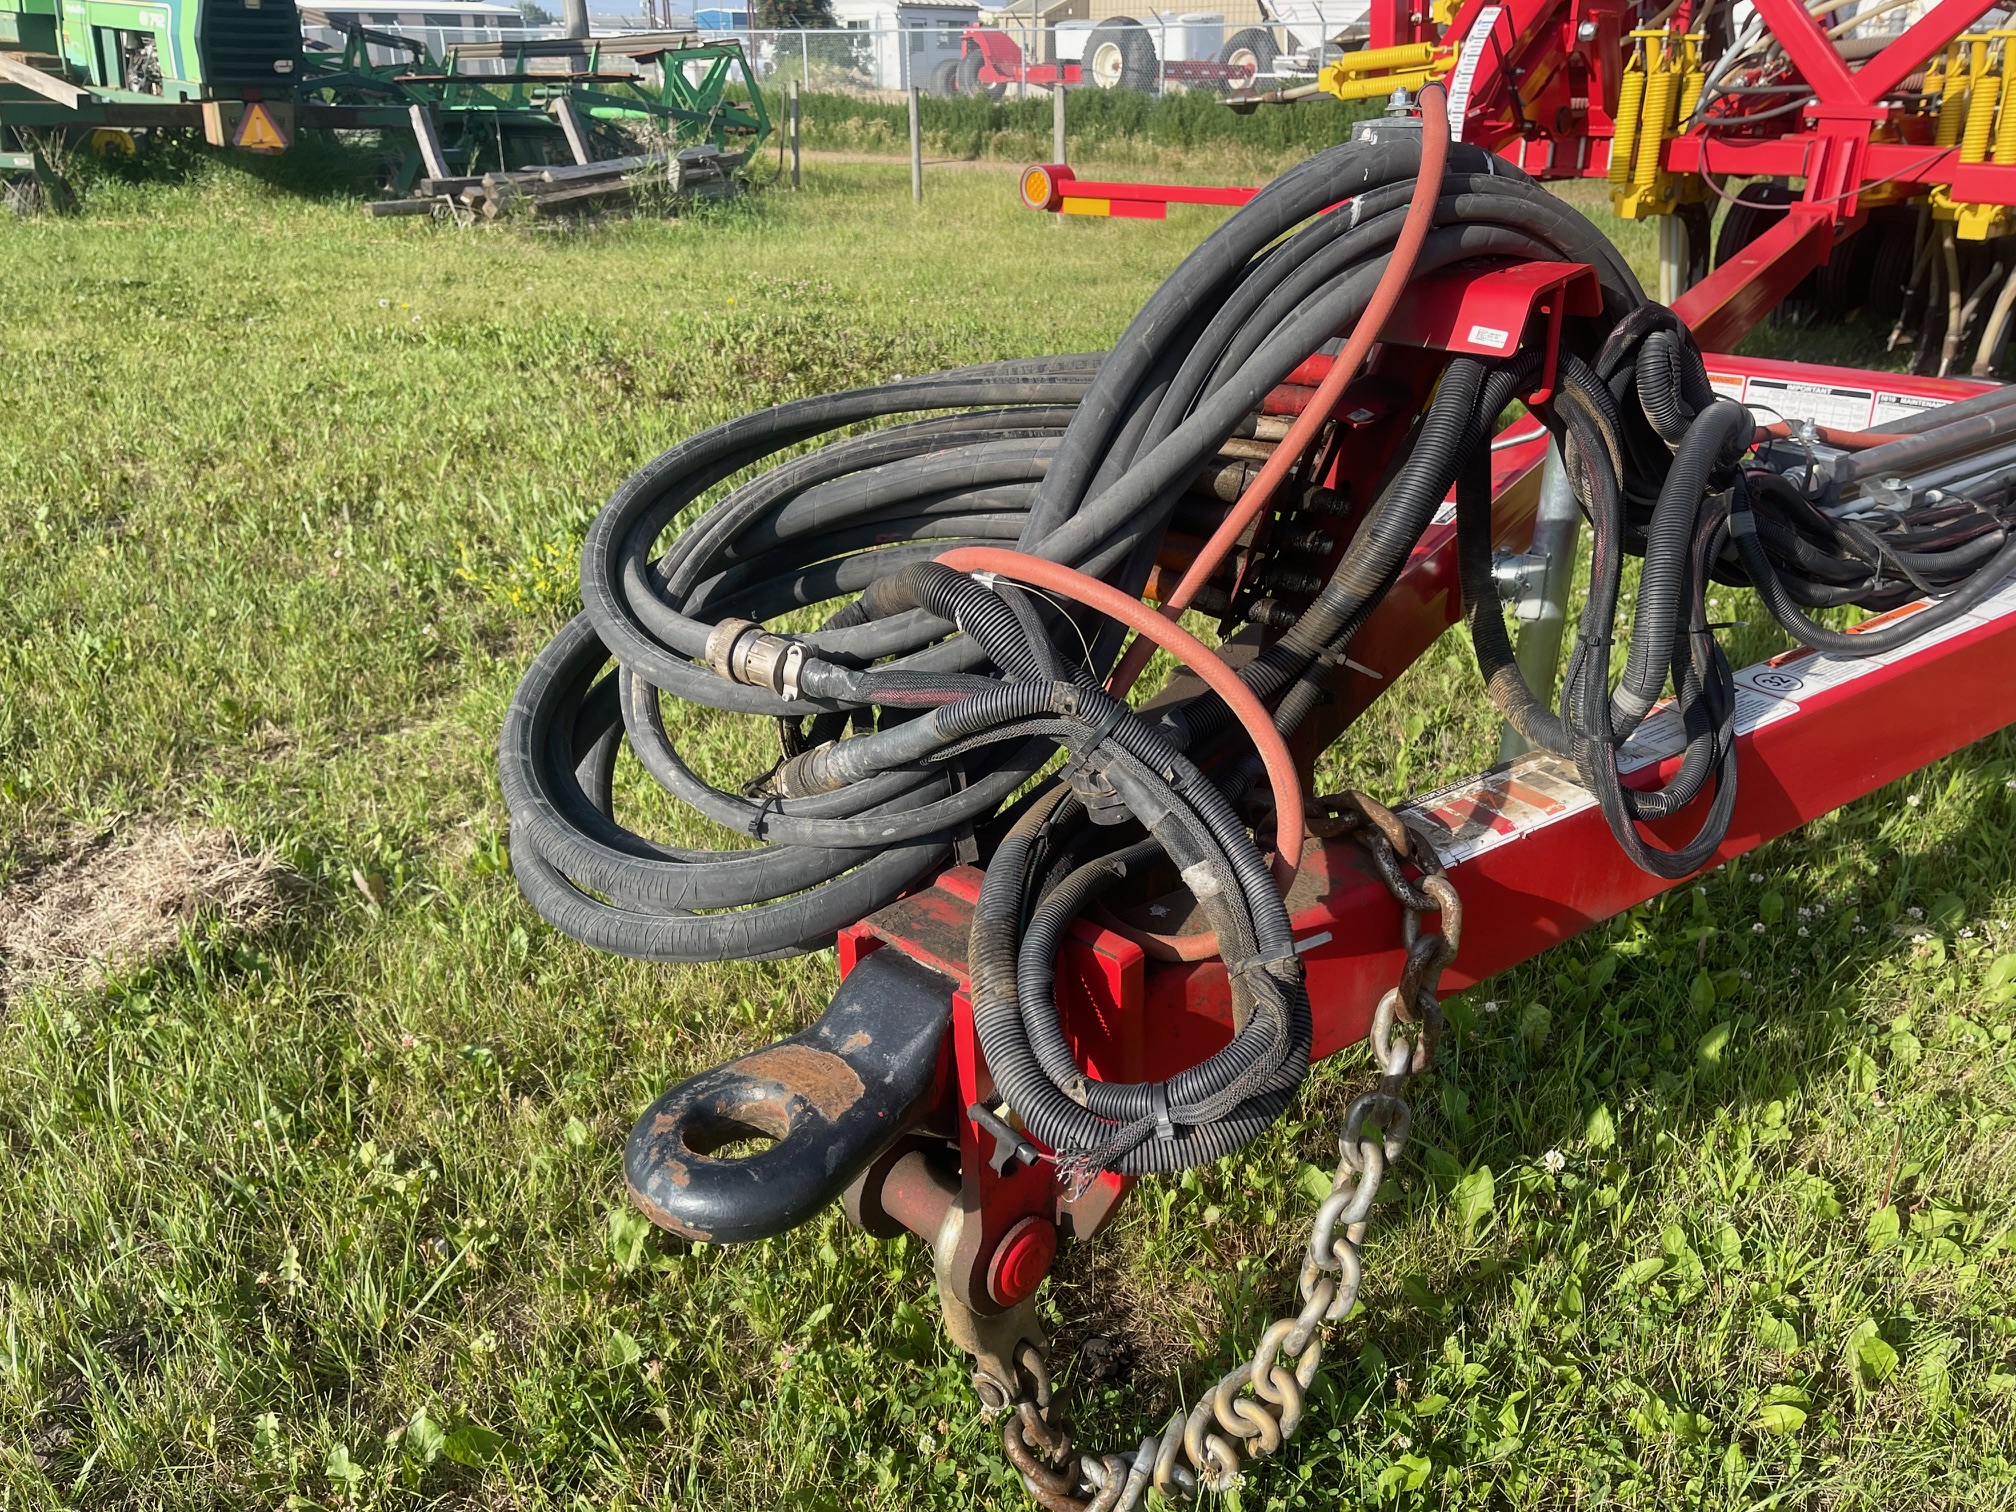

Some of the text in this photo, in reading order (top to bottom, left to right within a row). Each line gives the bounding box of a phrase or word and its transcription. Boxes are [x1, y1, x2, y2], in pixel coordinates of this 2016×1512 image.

[1786, 383, 1833, 396] IMPORTANT
[1900, 397, 1947, 409] MAINTENAN
[1761, 675, 1791, 687] 32
[1418, 787, 1448, 802] COUPLER
[1447, 779, 1469, 791] COLOR
